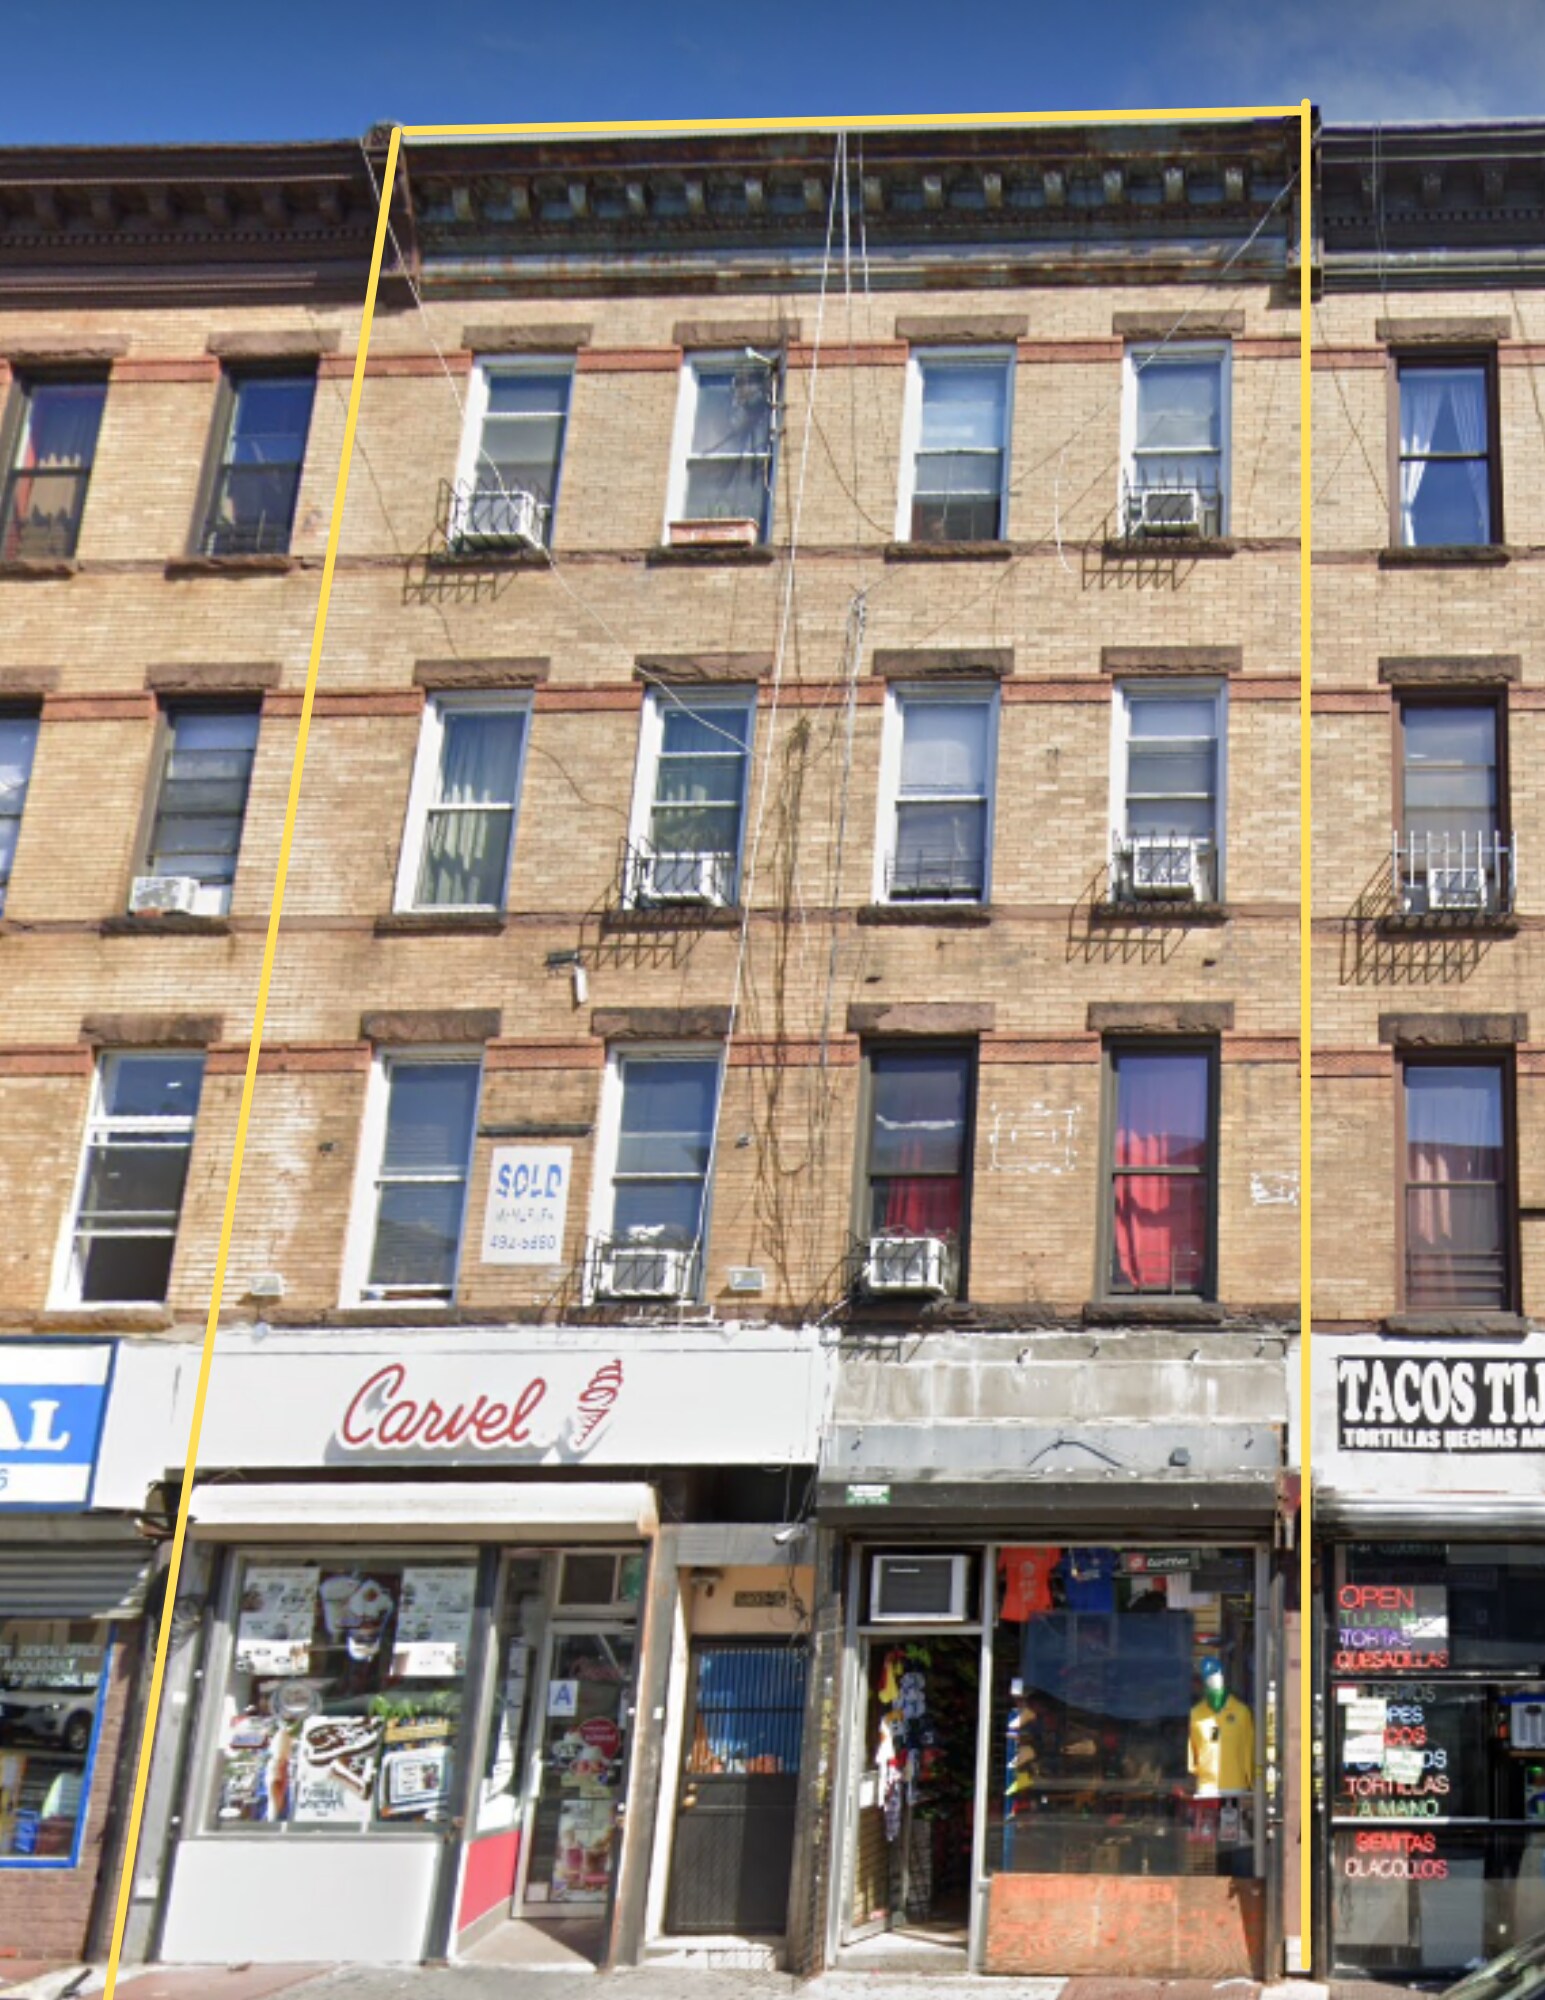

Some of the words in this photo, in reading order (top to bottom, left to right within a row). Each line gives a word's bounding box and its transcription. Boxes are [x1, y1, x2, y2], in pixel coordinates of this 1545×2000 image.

[496, 1163, 562, 1198] SOLD
[1338, 1359, 1477, 1424] TACOS
[342, 1363, 546, 1444] Carvel
[1343, 1427, 1441, 1447] TORTILLAS
[1444, 1428, 1518, 1448] HECHAS
[1338, 1585, 1415, 1609] OPEN
[1339, 1628, 1413, 1648] TORTAS
[1334, 1650, 1448, 1669] QUESADILLAS
[552, 1683, 573, 1706] A
